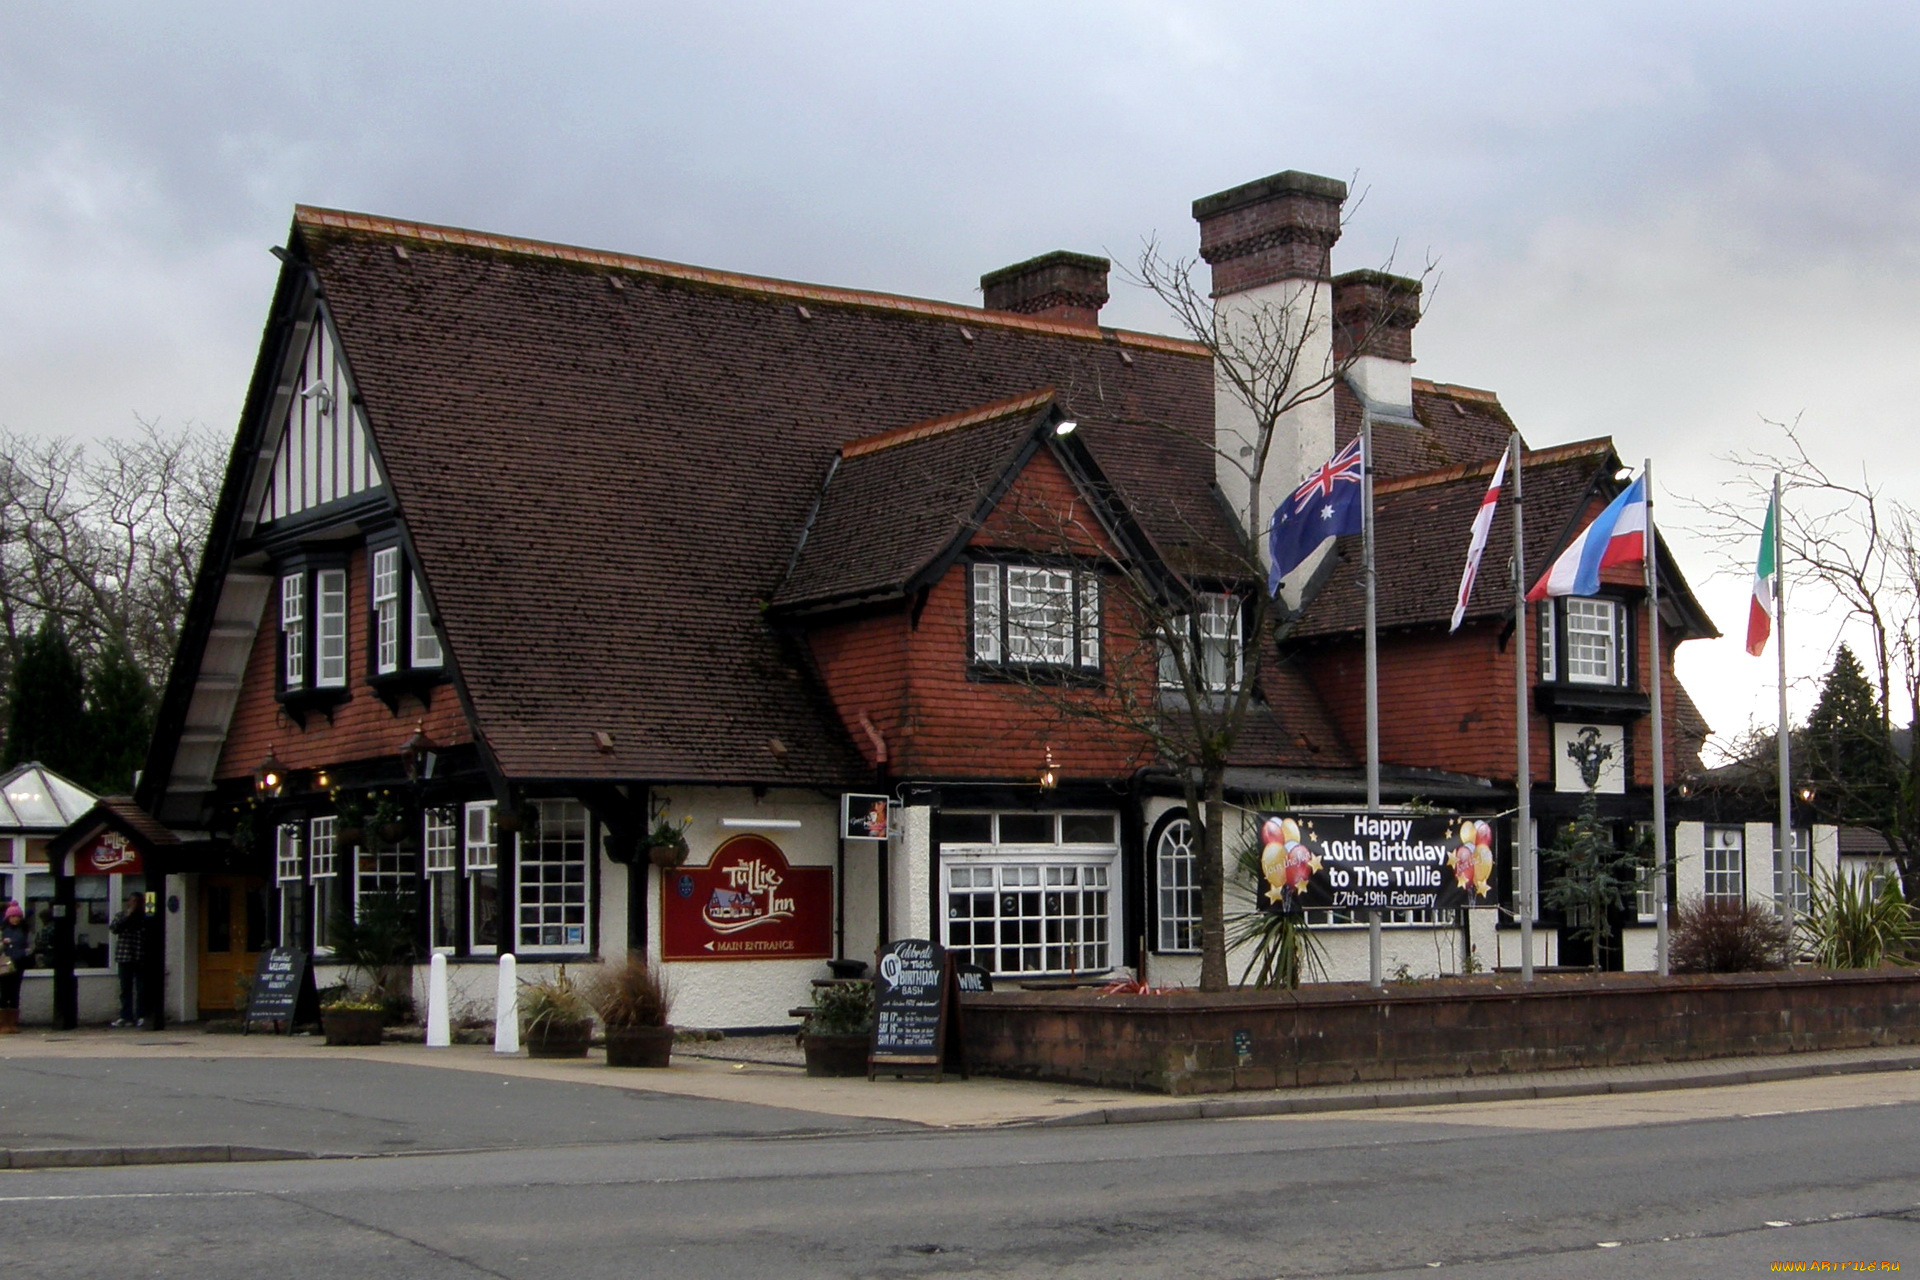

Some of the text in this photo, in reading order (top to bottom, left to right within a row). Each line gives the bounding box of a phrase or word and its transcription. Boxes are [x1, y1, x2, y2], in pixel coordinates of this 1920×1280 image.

[1353, 815, 1412, 840] Happy
[1321, 840, 1446, 866] 10th Birthday
[722, 859, 784, 894] Tullie
[1329, 867, 1350, 887] to
[1353, 866, 1389, 887] The
[1391, 866, 1441, 887] Tullie
[768, 886, 795, 915] Inn
[1332, 891, 1437, 908] 17th-19th February
[717, 941, 795, 951] MAIN ENTRANCE
[894, 942, 933, 958] Celebrate
[899, 970, 940, 986] BIRTHDAY
[957, 973, 984, 990] WINE
[902, 986, 924, 996] BASH
